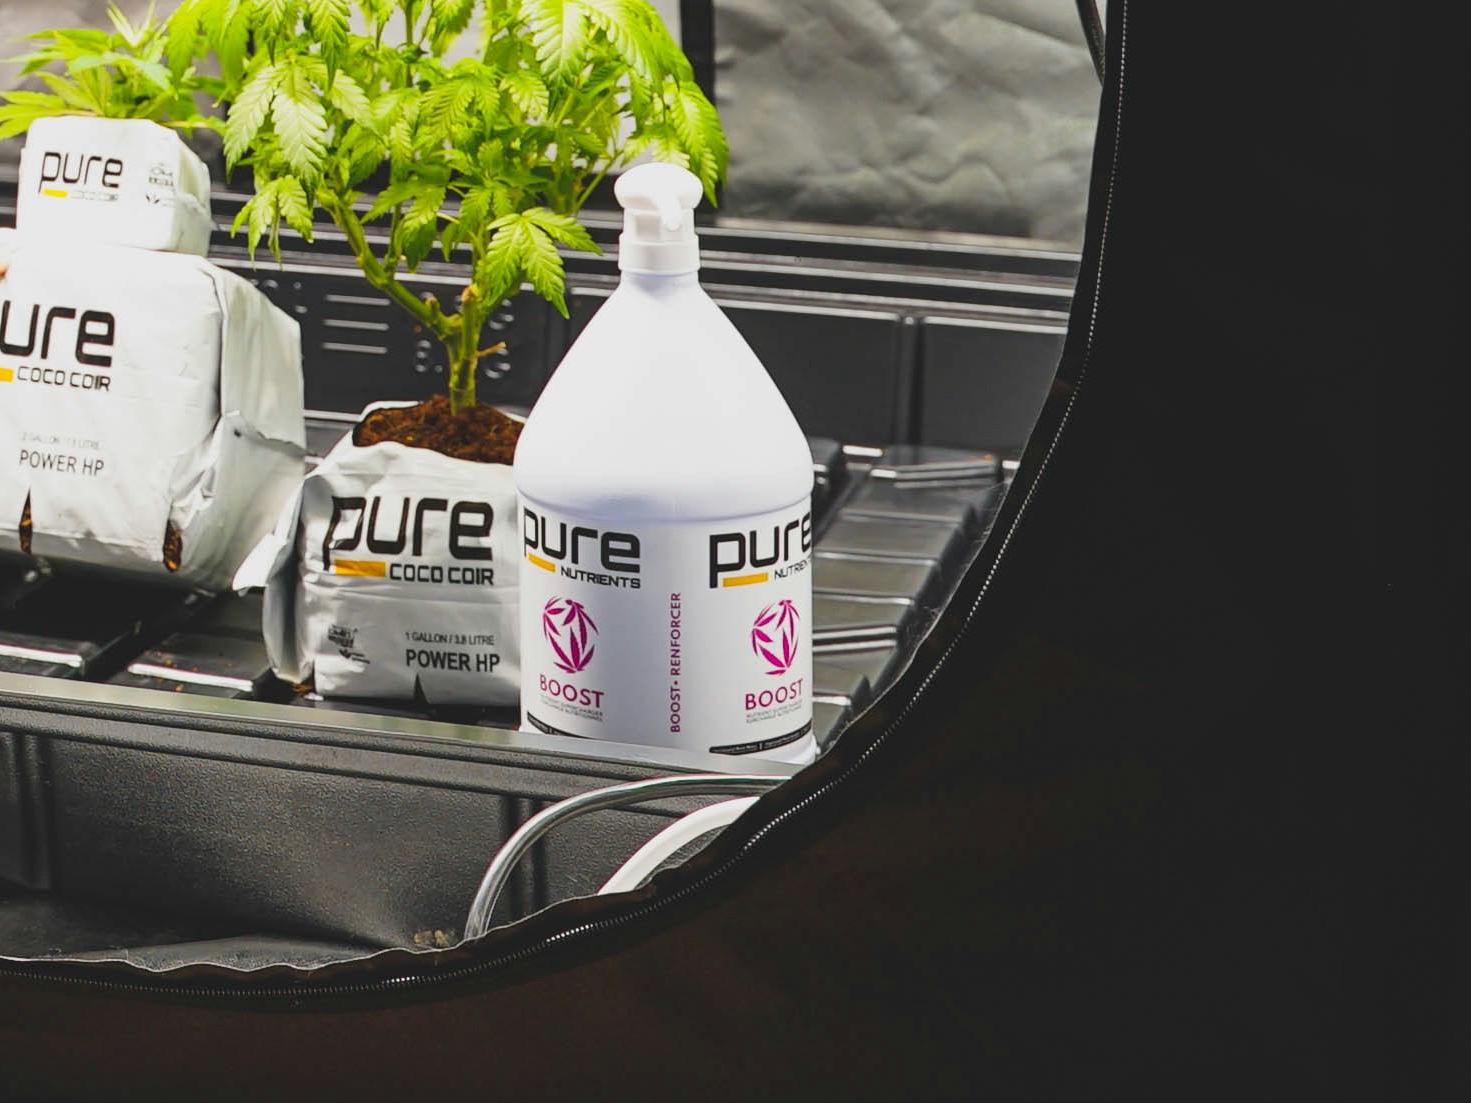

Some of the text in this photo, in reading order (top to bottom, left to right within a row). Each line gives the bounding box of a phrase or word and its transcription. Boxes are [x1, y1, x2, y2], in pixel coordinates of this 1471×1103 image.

[38, 151, 123, 194] pure
[17, 366, 111, 391] COCO COIR
[19, 449, 104, 475] POWER HP
[323, 496, 494, 571] pure
[523, 507, 641, 573] pure
[389, 563, 494, 585] COCO COIR
[560, 565, 641, 589] NUTRIENTS
[412, 632, 448, 643] GALLON
[468, 634, 495, 646] LITRE
[669, 592, 682, 676] RENFORCER
[406, 649, 500, 673] POWER HP
[539, 674, 604, 708] BOOST
[745, 678, 804, 711] BOOST
